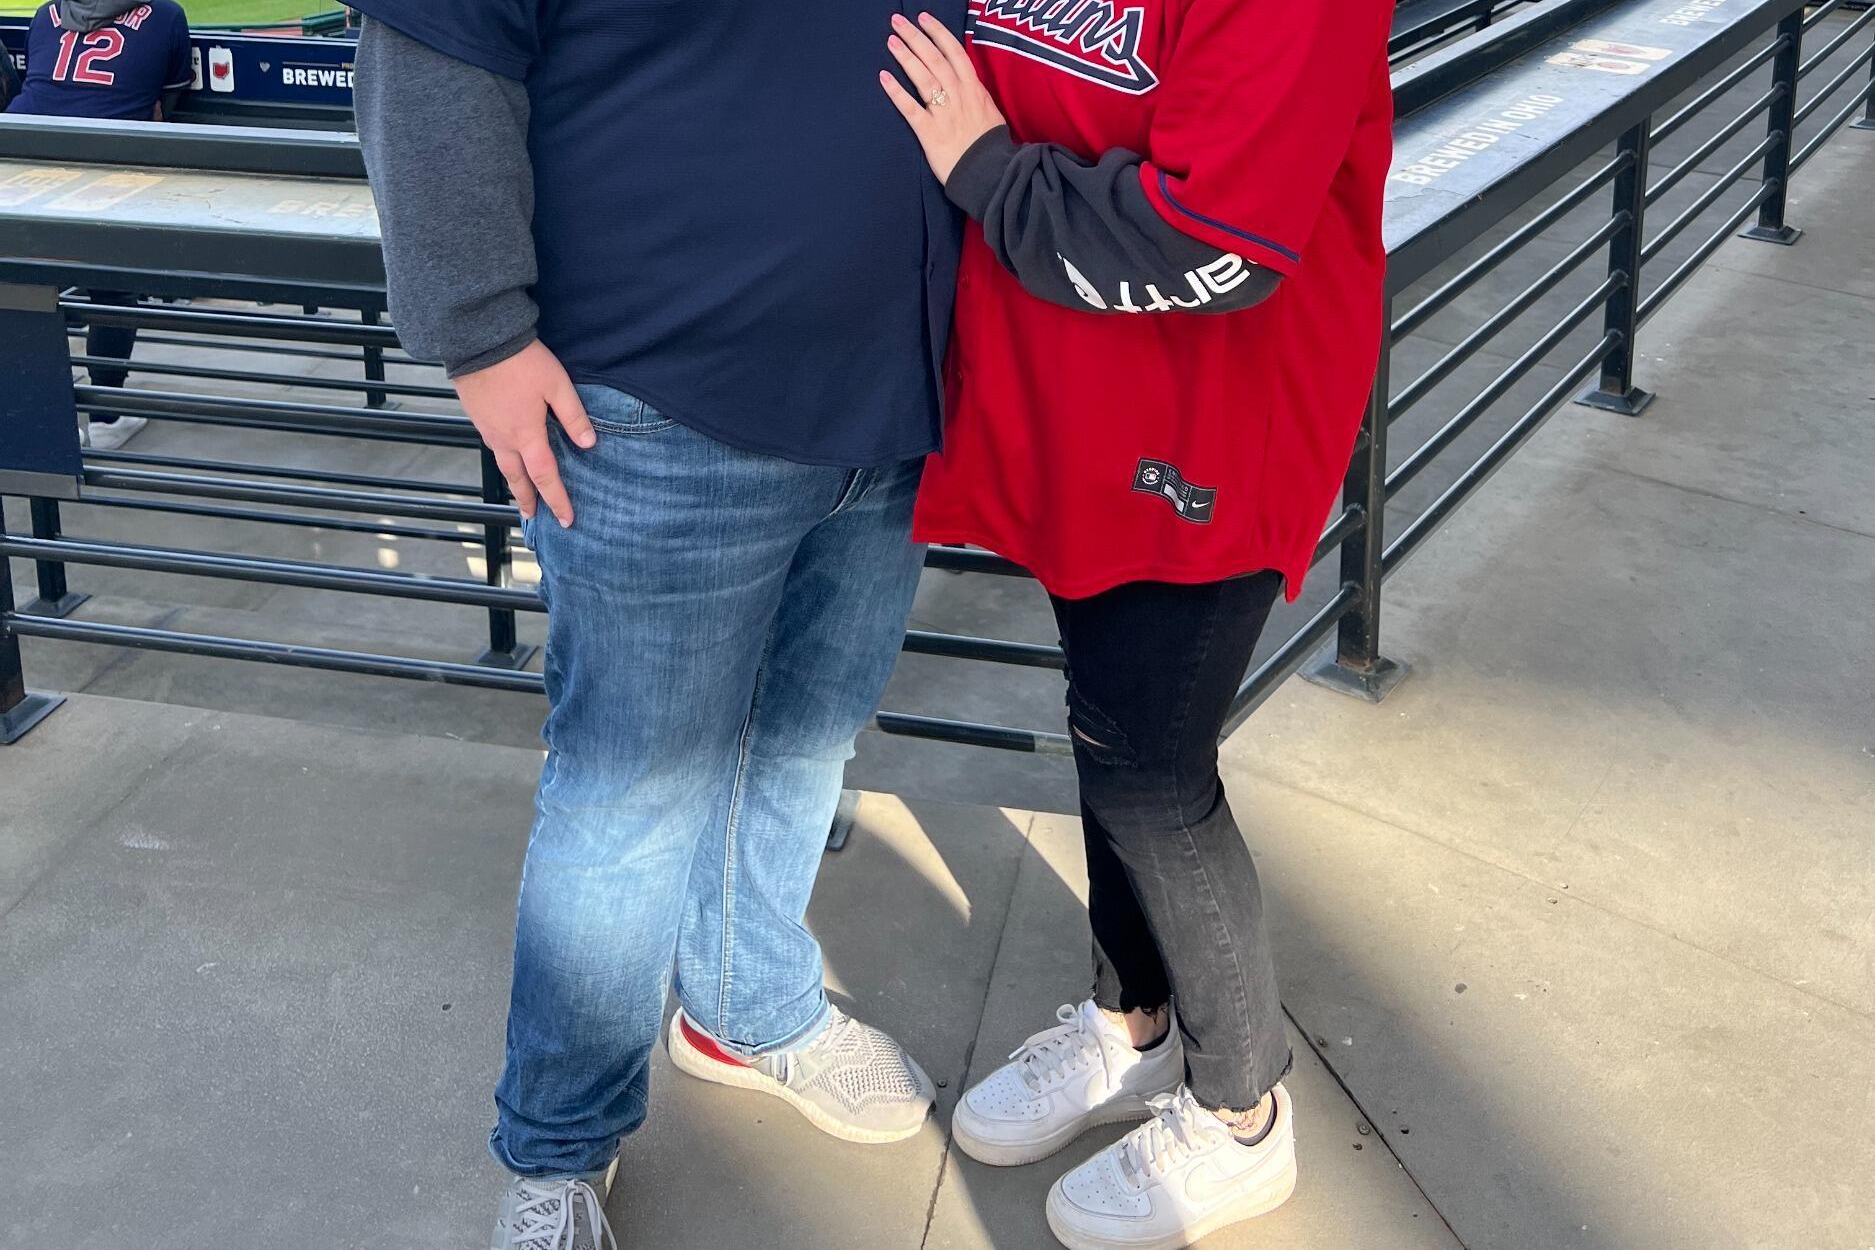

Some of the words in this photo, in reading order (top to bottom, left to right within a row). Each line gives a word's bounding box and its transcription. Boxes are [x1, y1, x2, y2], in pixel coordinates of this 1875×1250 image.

[53, 27, 125, 86] 12
[282, 68, 354, 88] BREWE
[1486, 118, 1524, 135] IN
[1501, 94, 1565, 120] OHIO
[1390, 131, 1500, 186] BREWED
[1113, 252, 1259, 313] artt
